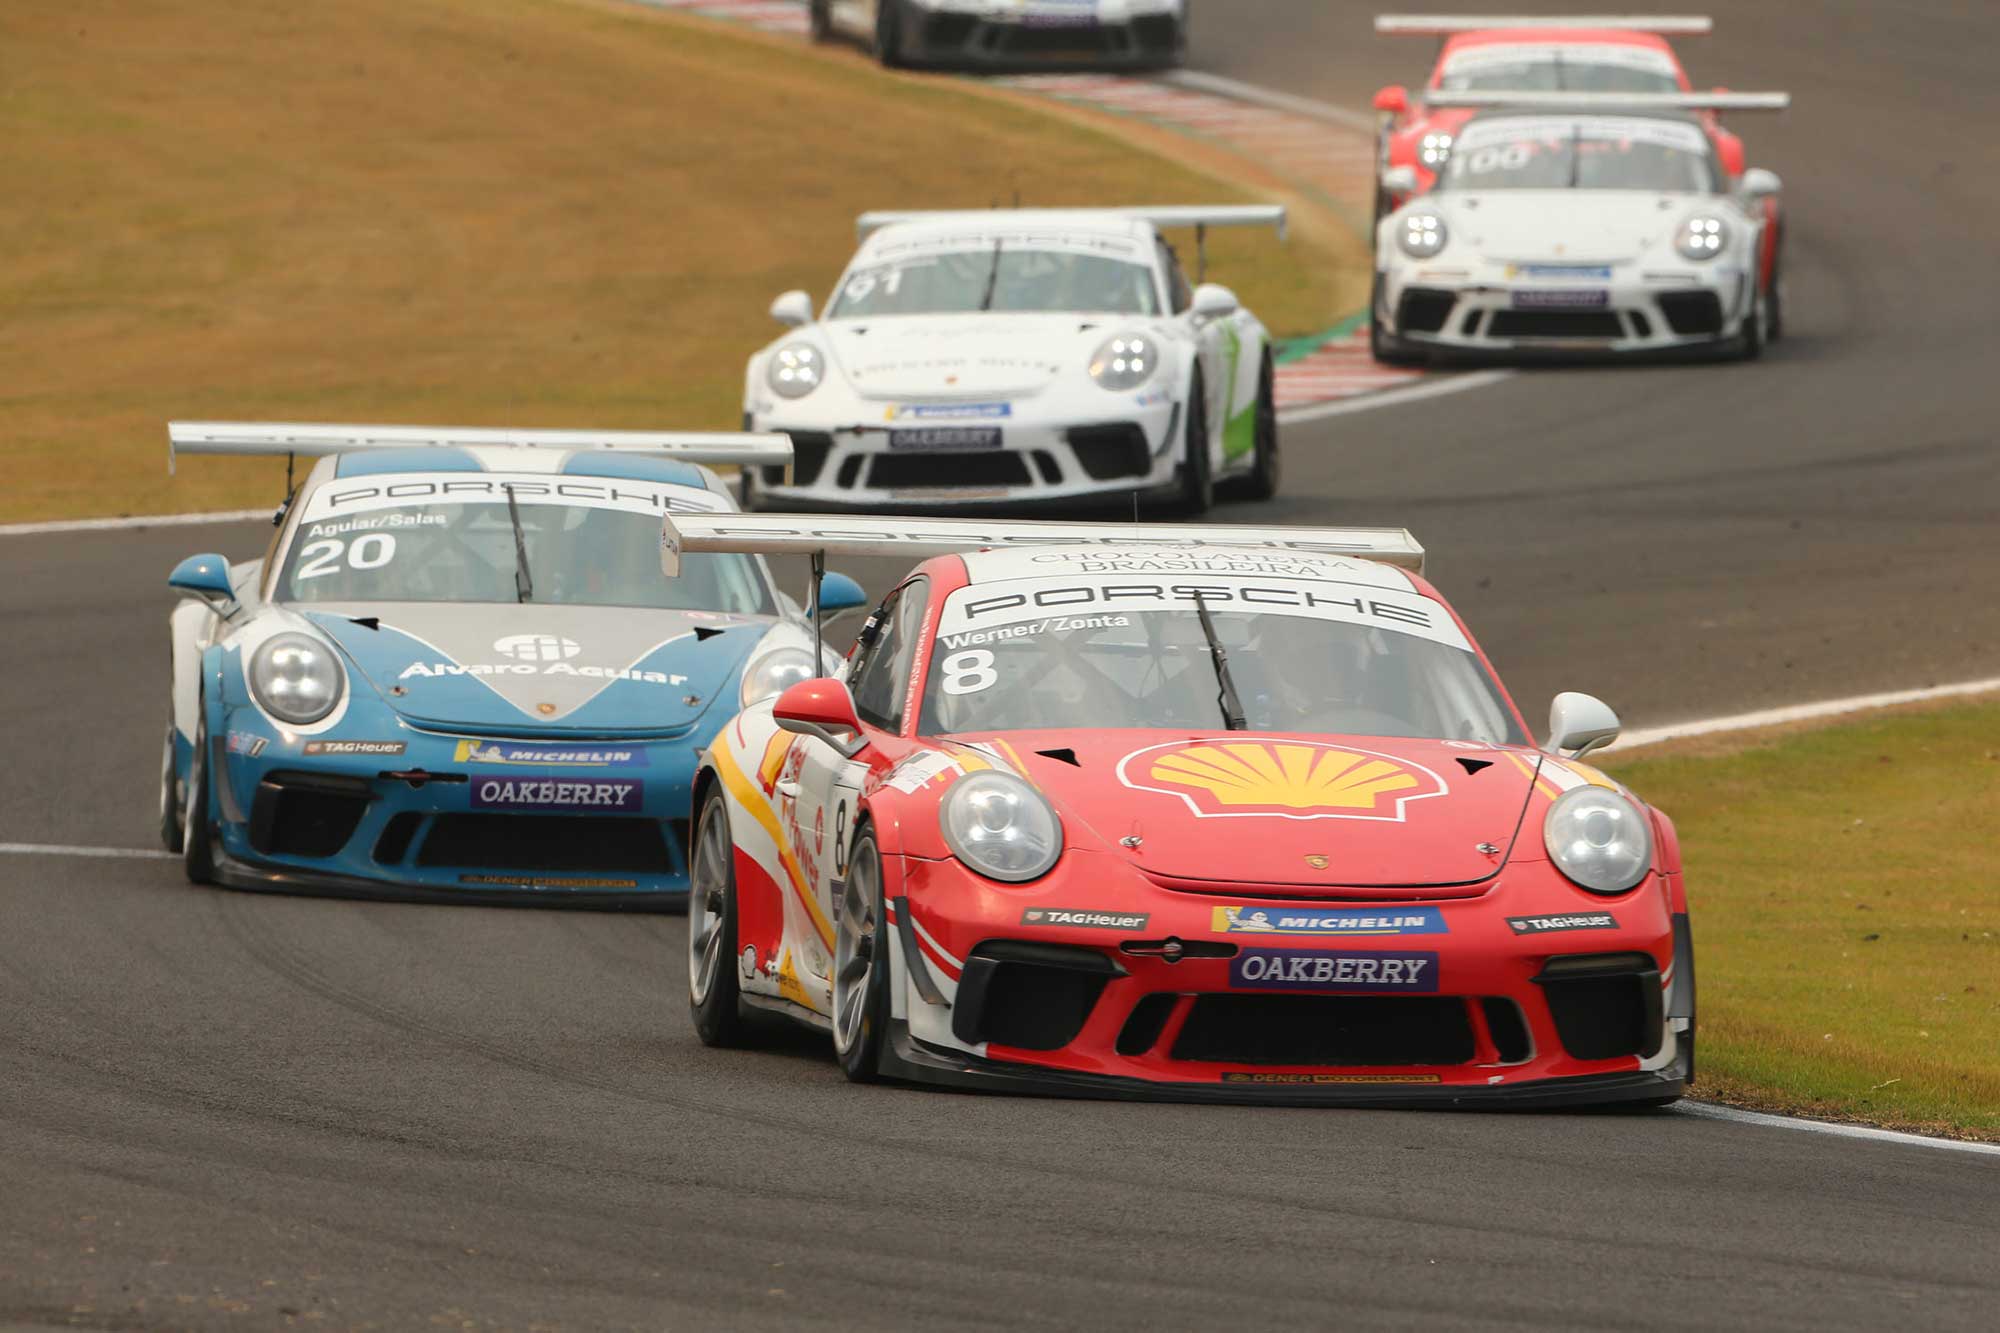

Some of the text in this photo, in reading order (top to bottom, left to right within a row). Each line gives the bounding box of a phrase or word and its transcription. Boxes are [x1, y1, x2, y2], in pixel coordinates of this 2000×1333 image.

[330, 482, 715, 513] PORSCHE
[309, 512, 447, 538] Aguiar/Salas
[297, 532, 397, 580] 20
[1031, 550, 1358, 571] CHOCOLATERIA
[1080, 560, 1323, 577] BRASILEIRA
[964, 585, 1433, 629] PORSCHE
[942, 616, 1130, 650] Werner/Zonta
[543, 662, 689, 686] Aguiar
[942, 649, 998, 695] 8
[510, 751, 632, 762] MICHELIN
[480, 780, 633, 806] OAKBERRY
[835, 799, 847, 876] 8
[1278, 916, 1425, 929] MICHELIN
[1241, 956, 1428, 984] OAKBERRY
[1252, 1073, 1312, 1083] DENER
